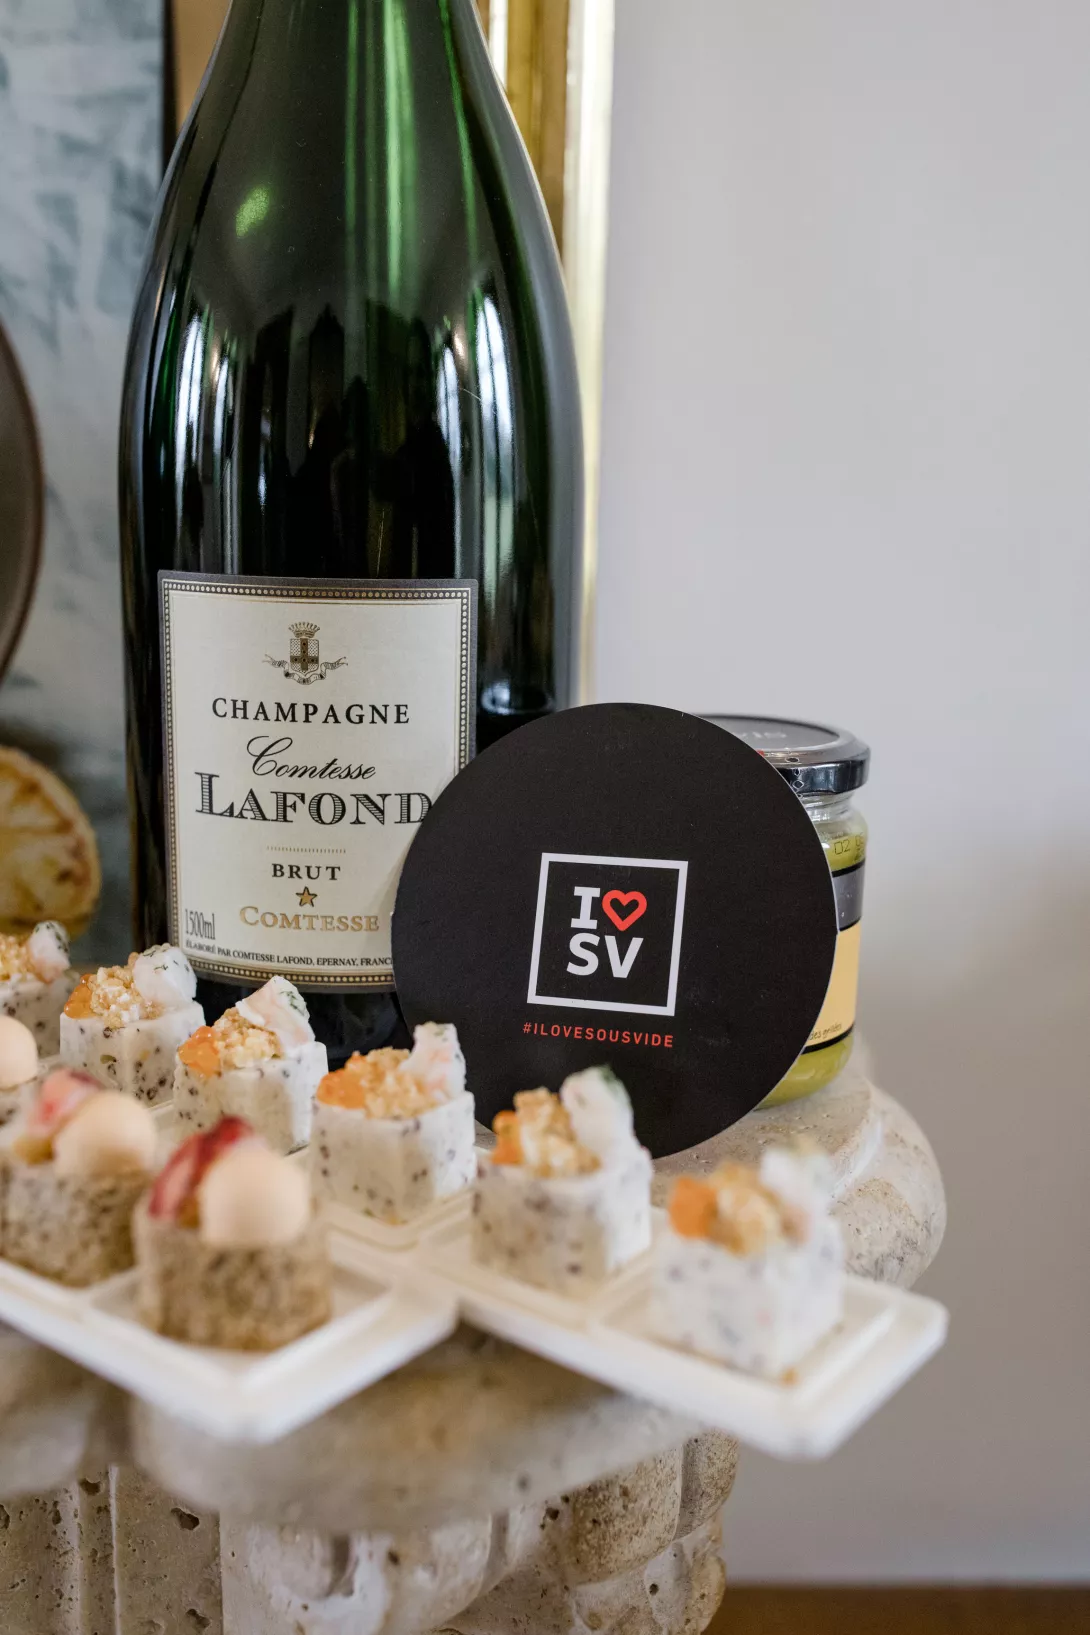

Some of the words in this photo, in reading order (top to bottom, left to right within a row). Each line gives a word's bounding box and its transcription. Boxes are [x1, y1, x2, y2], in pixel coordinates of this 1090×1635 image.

[212, 698, 410, 724] CHAMPAGNE
[246, 735, 377, 780] Comtesse
[194, 771, 433, 826] LAFOND
[271, 863, 341, 881] BRUT
[239, 905, 380, 932] COMTESSE
[570, 886, 601, 930] I
[184, 908, 216, 940] 1500ml
[185, 938, 216, 955] ÉLABORÉ
[217, 946, 231, 957] PAR
[232, 949, 276, 963] COMTESSE
[276, 955, 315, 967] LAFOND,
[316, 957, 359, 967] EPERNAY,
[566, 932, 644, 979] SV
[523, 1021, 674, 1048] #ILOVESOUSVIDE
